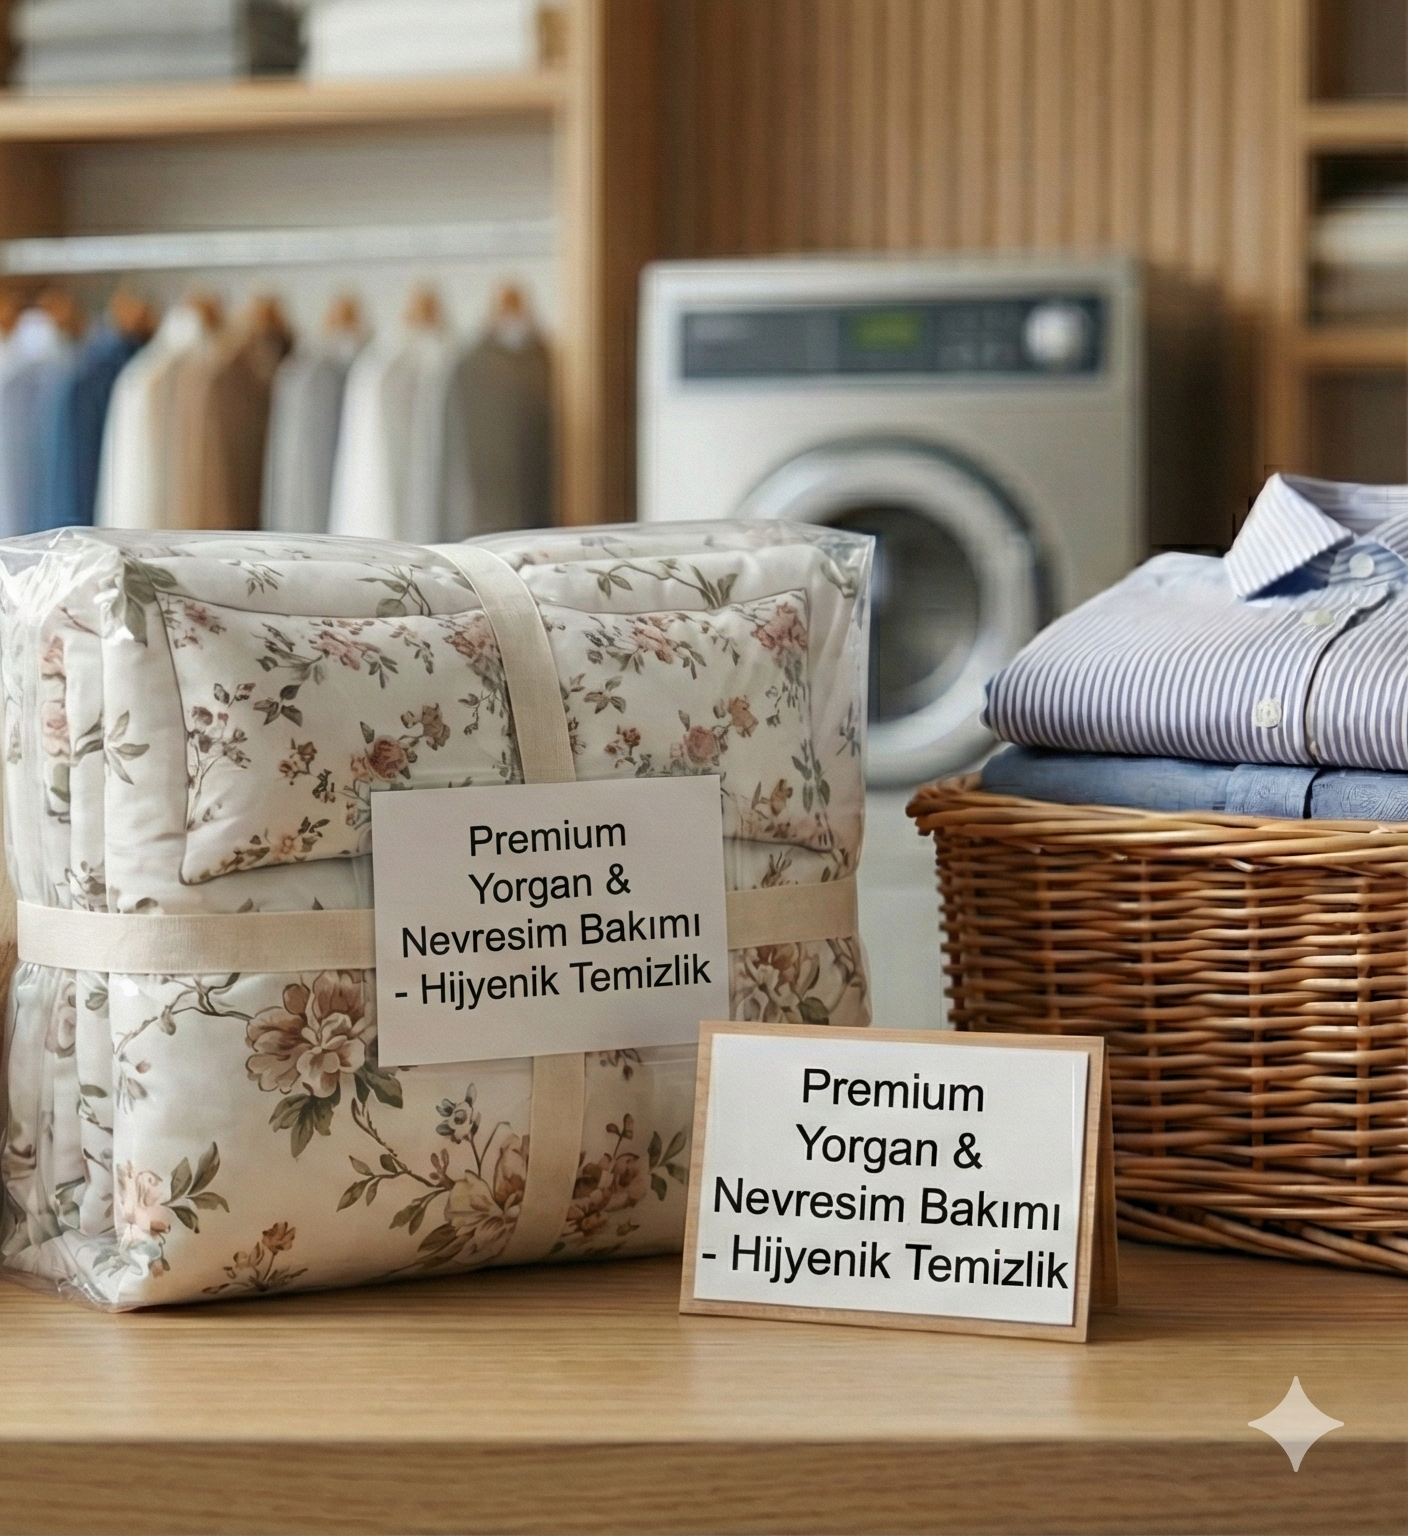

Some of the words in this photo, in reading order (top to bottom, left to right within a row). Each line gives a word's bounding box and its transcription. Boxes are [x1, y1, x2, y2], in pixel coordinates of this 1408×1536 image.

[469, 819, 626, 857] Premium
[467, 872, 592, 909] Yorgan
[605, 862, 632, 896] &
[402, 918, 567, 959] Nevresim
[580, 910, 701, 946] Bakımı
[394, 990, 408, 999] -
[421, 964, 560, 1011] Hijyenik
[569, 953, 712, 994] Temizlik
[802, 1068, 984, 1113] Premium
[795, 1123, 938, 1174] Yorgan
[953, 1132, 983, 1170] &
[714, 1176, 905, 1223] Nevresim
[920, 1187, 1060, 1231] Bakımı
[701, 1252, 717, 1260] -
[732, 1234, 891, 1284] Hijyenik
[904, 1243, 1069, 1289] Temizlik
